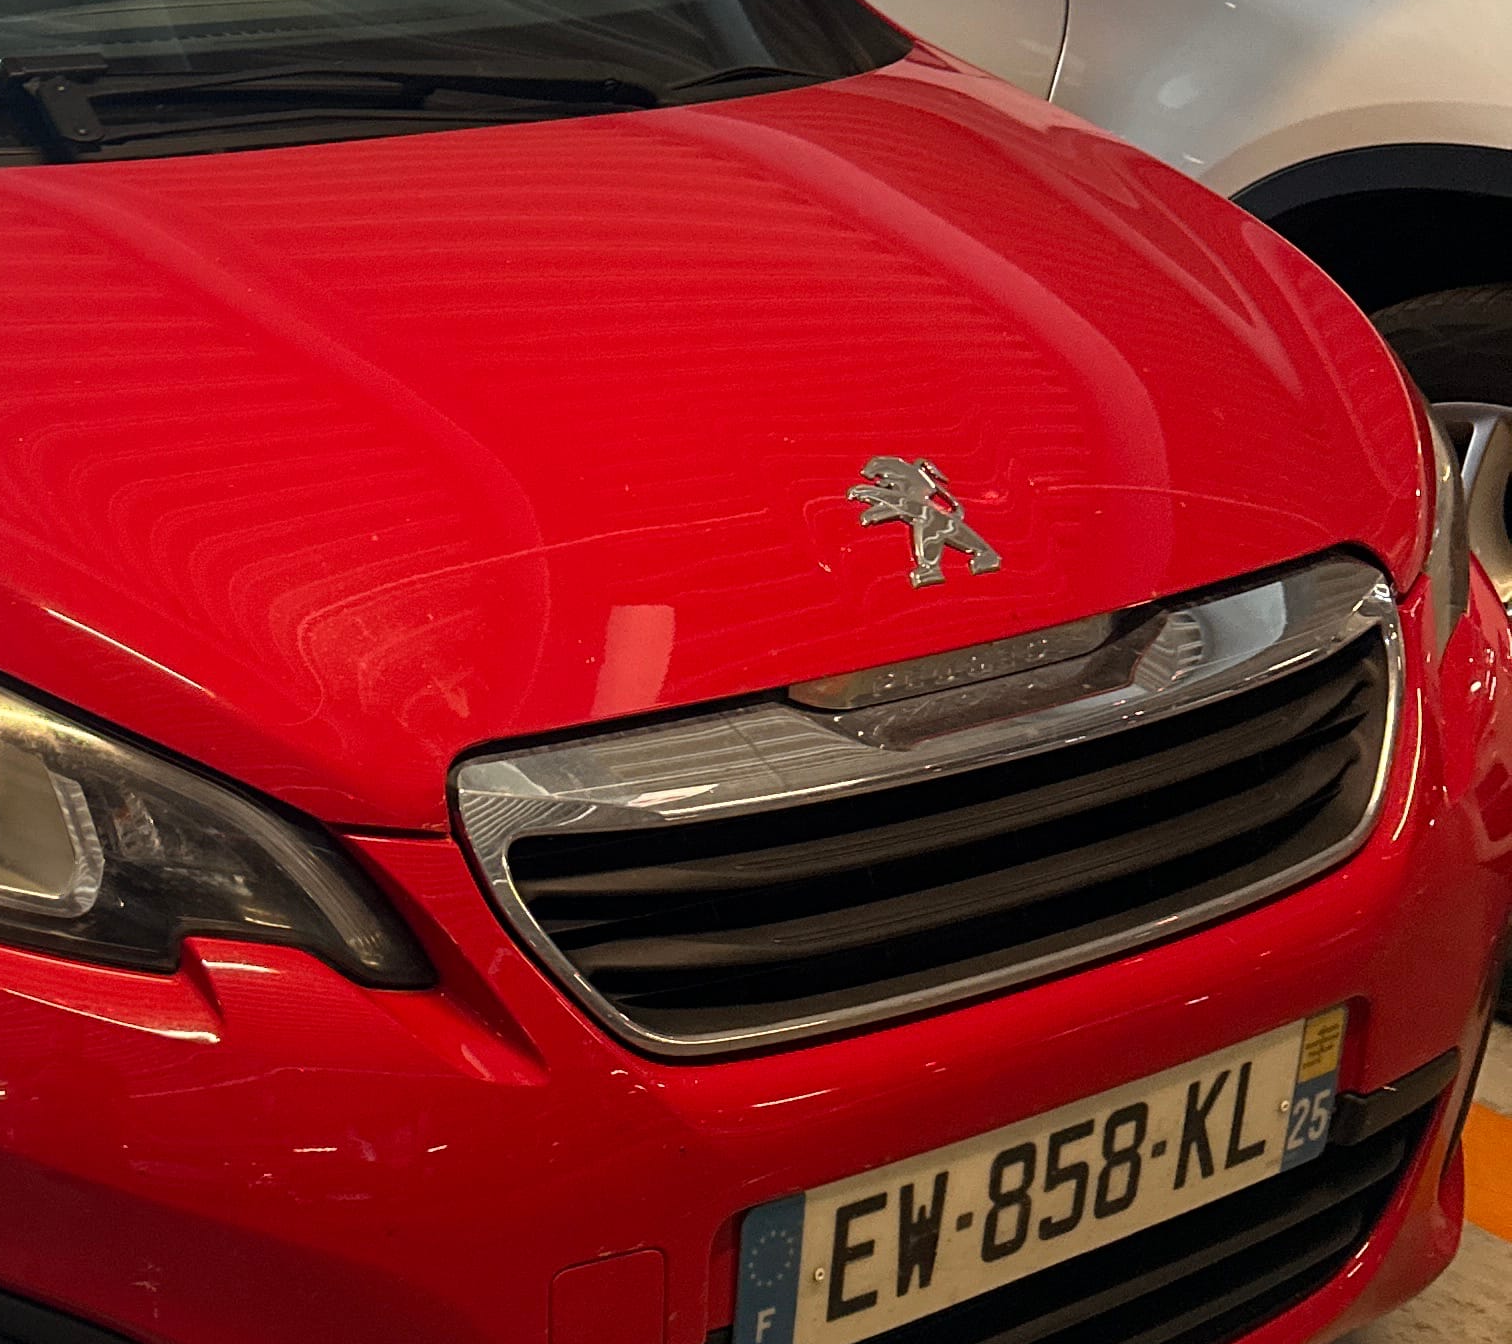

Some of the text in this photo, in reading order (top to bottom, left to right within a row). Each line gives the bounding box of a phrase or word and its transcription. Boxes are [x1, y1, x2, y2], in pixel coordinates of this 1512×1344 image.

[755, 1061, 1331, 1344] F EW-858-KL 25
